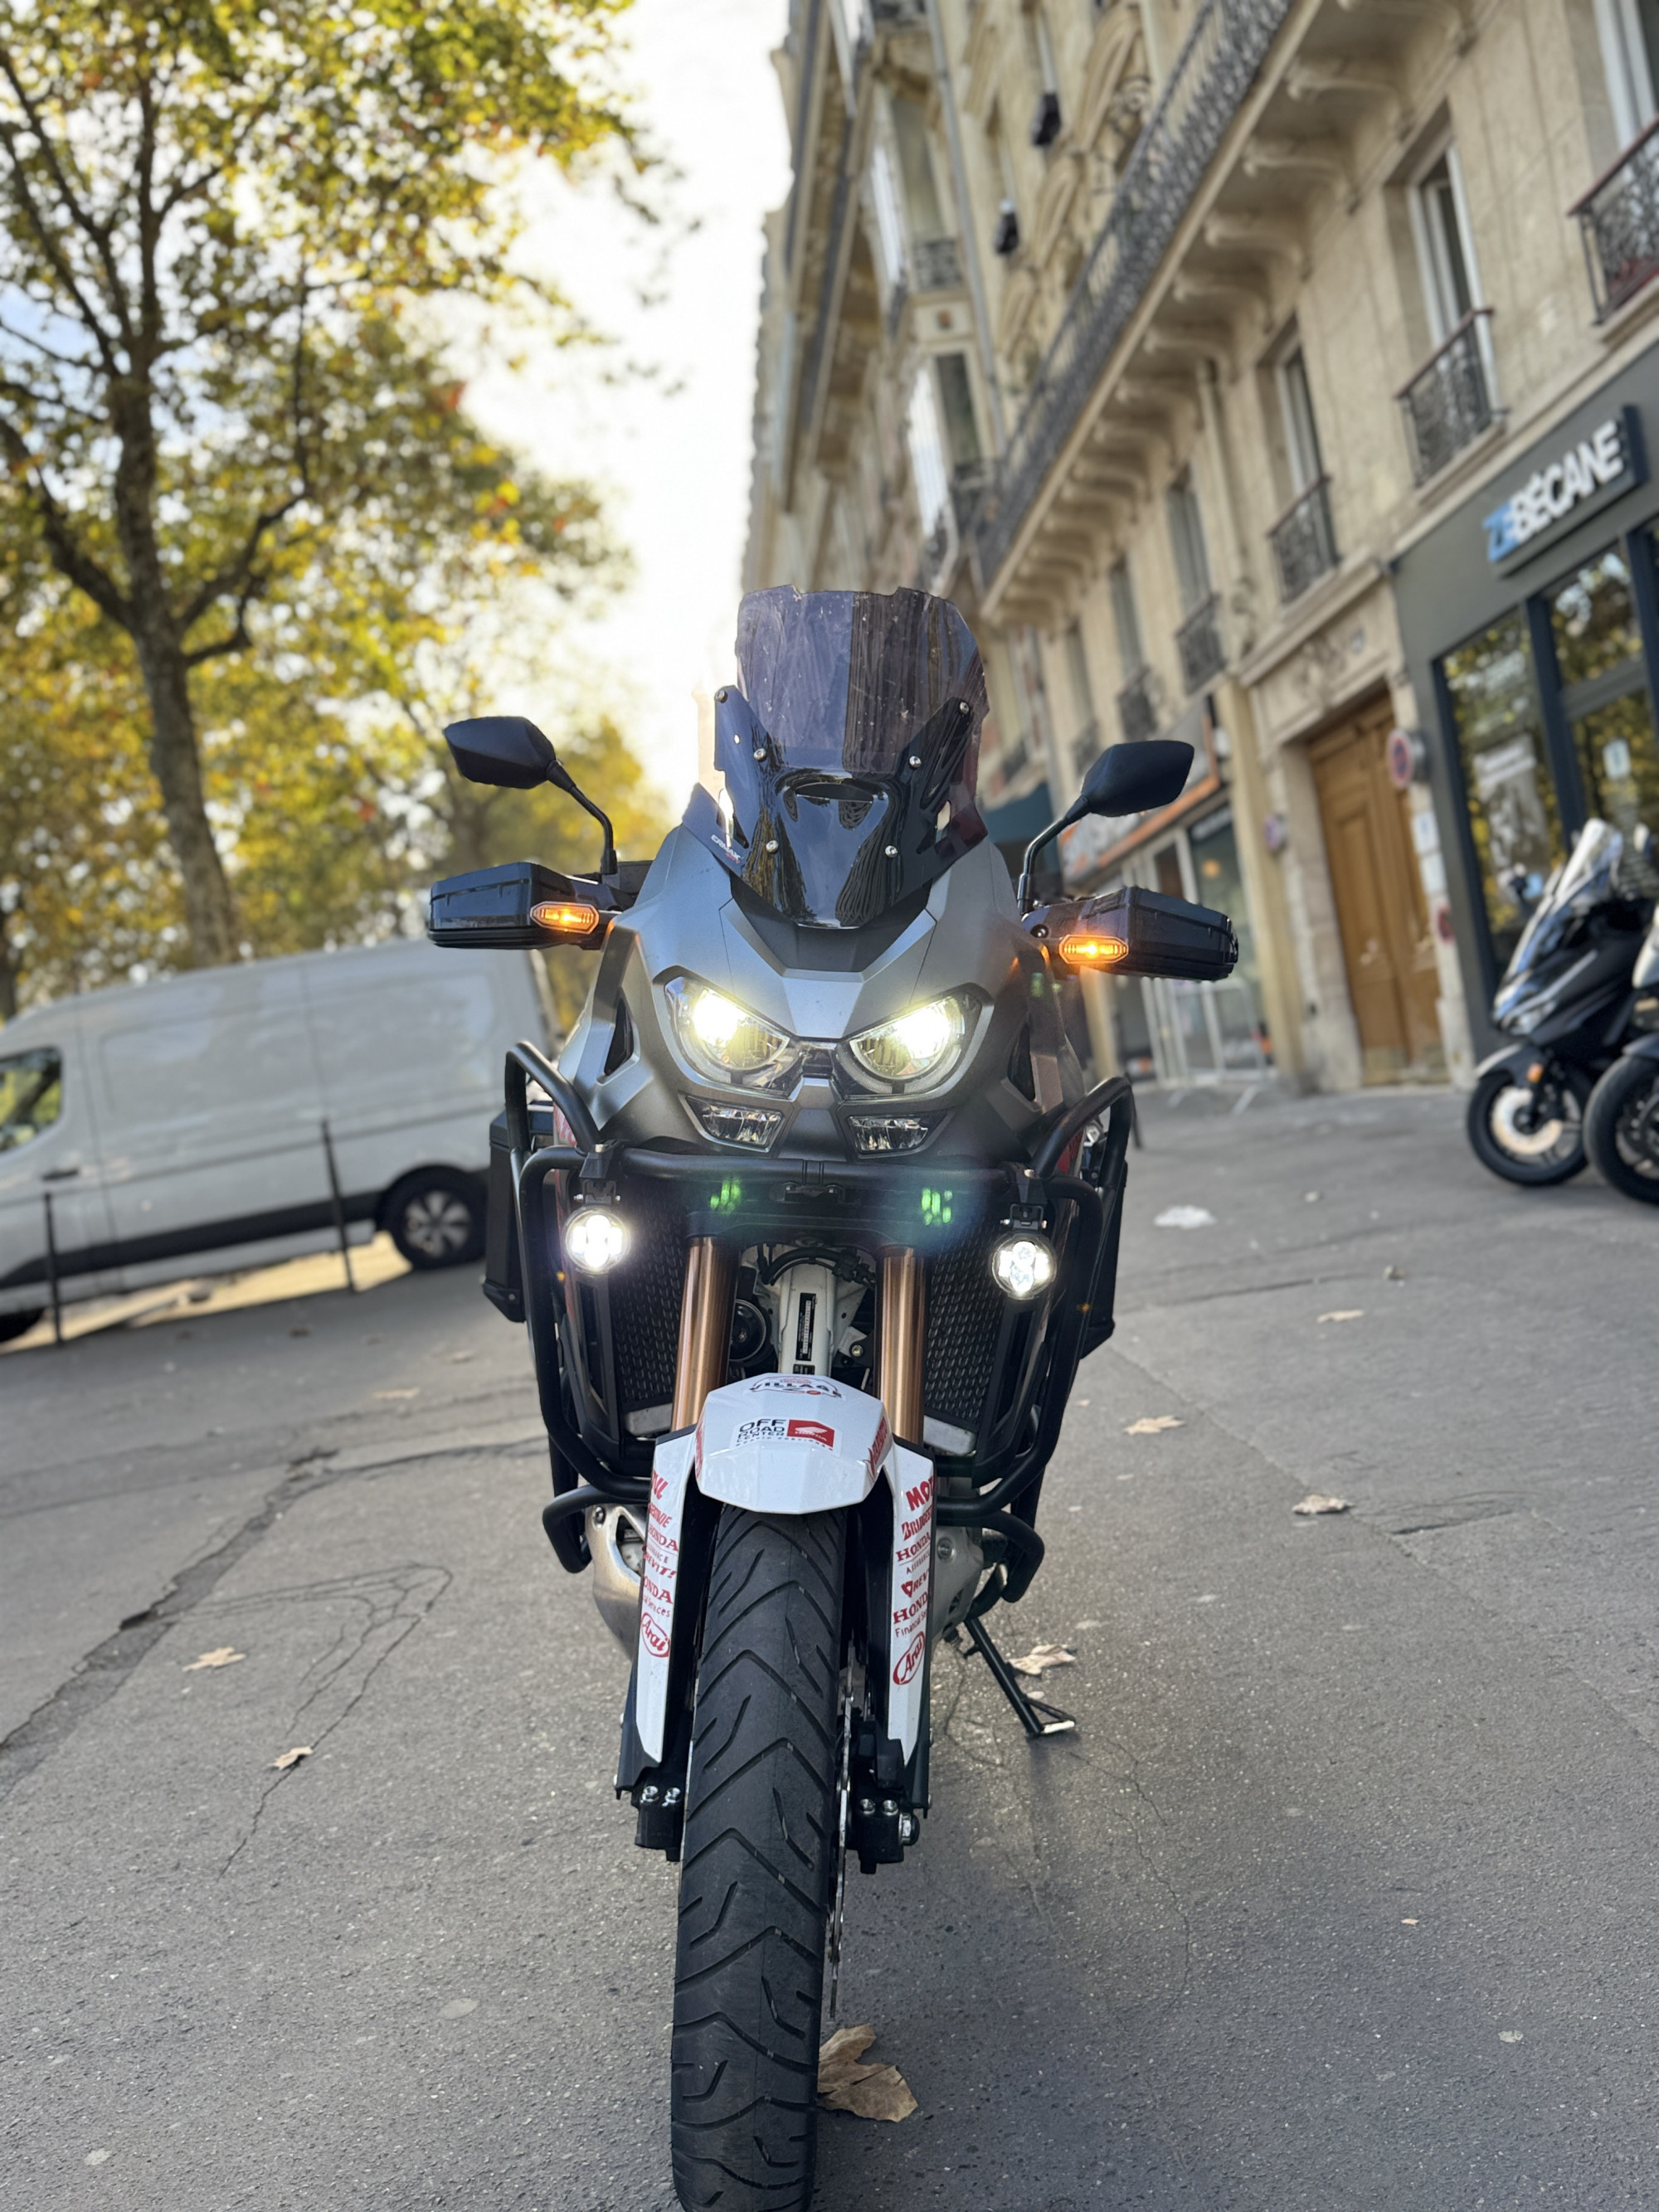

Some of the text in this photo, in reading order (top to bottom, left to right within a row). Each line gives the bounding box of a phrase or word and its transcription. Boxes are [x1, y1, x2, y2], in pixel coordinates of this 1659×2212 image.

[737, 1426, 786, 1439] ROAD
[739, 1418, 787, 1432] OFF
[896, 1531, 931, 1562] HONDA
[642, 1619, 669, 1651] Arai
